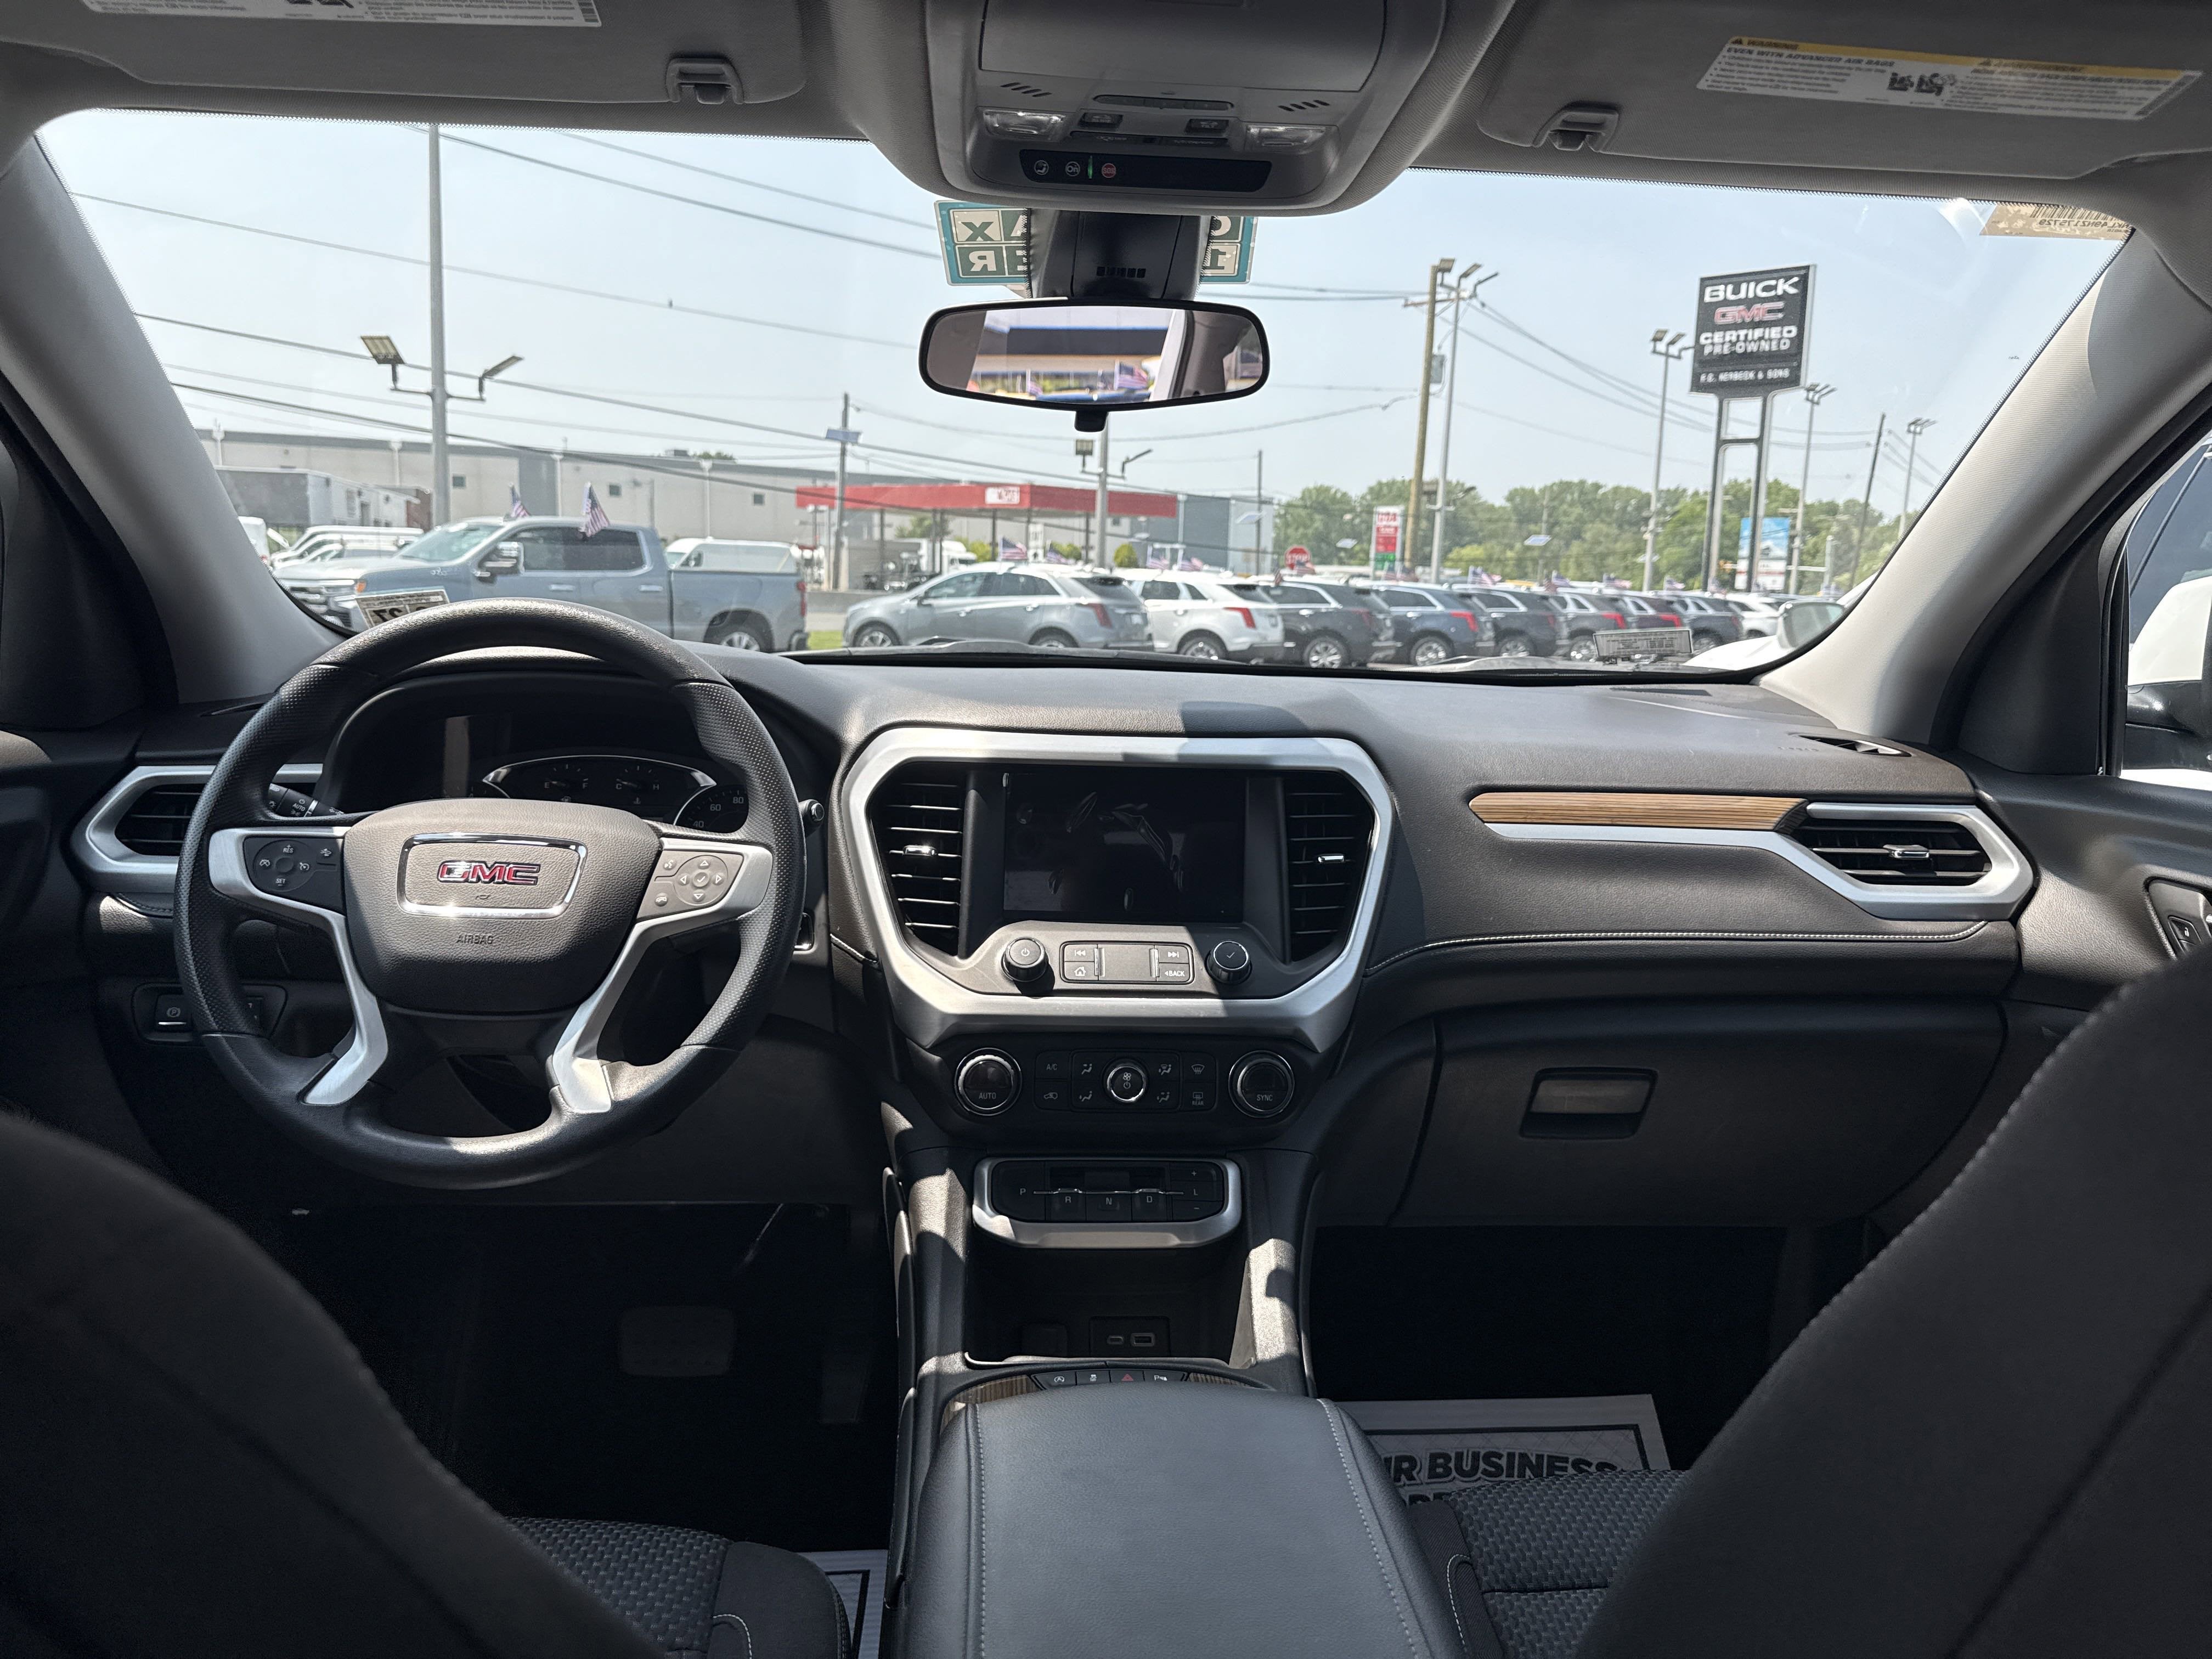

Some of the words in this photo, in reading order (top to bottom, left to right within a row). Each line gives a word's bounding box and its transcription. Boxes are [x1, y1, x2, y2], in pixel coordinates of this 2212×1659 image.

[1703, 276, 1800, 303] BUICK
[1714, 301, 1785, 325] GMC
[1699, 325, 1798, 345] CERTIFIED
[1703, 338, 1791, 356] PRE-OWNED
[292, 803, 306, 812] AUTO
[437, 860, 541, 886] GMC
[456, 934, 494, 945] AIRBAG
[1046, 1063, 1058, 1071] A/C
[978, 1092, 997, 1100] AUTO
[1256, 1094, 1273, 1102] SYNC
[1019, 1188, 1026, 1196] P
[1065, 1195, 1071, 1204] R
[1105, 1197, 1113, 1205] N
[1146, 1195, 1153, 1204] D
